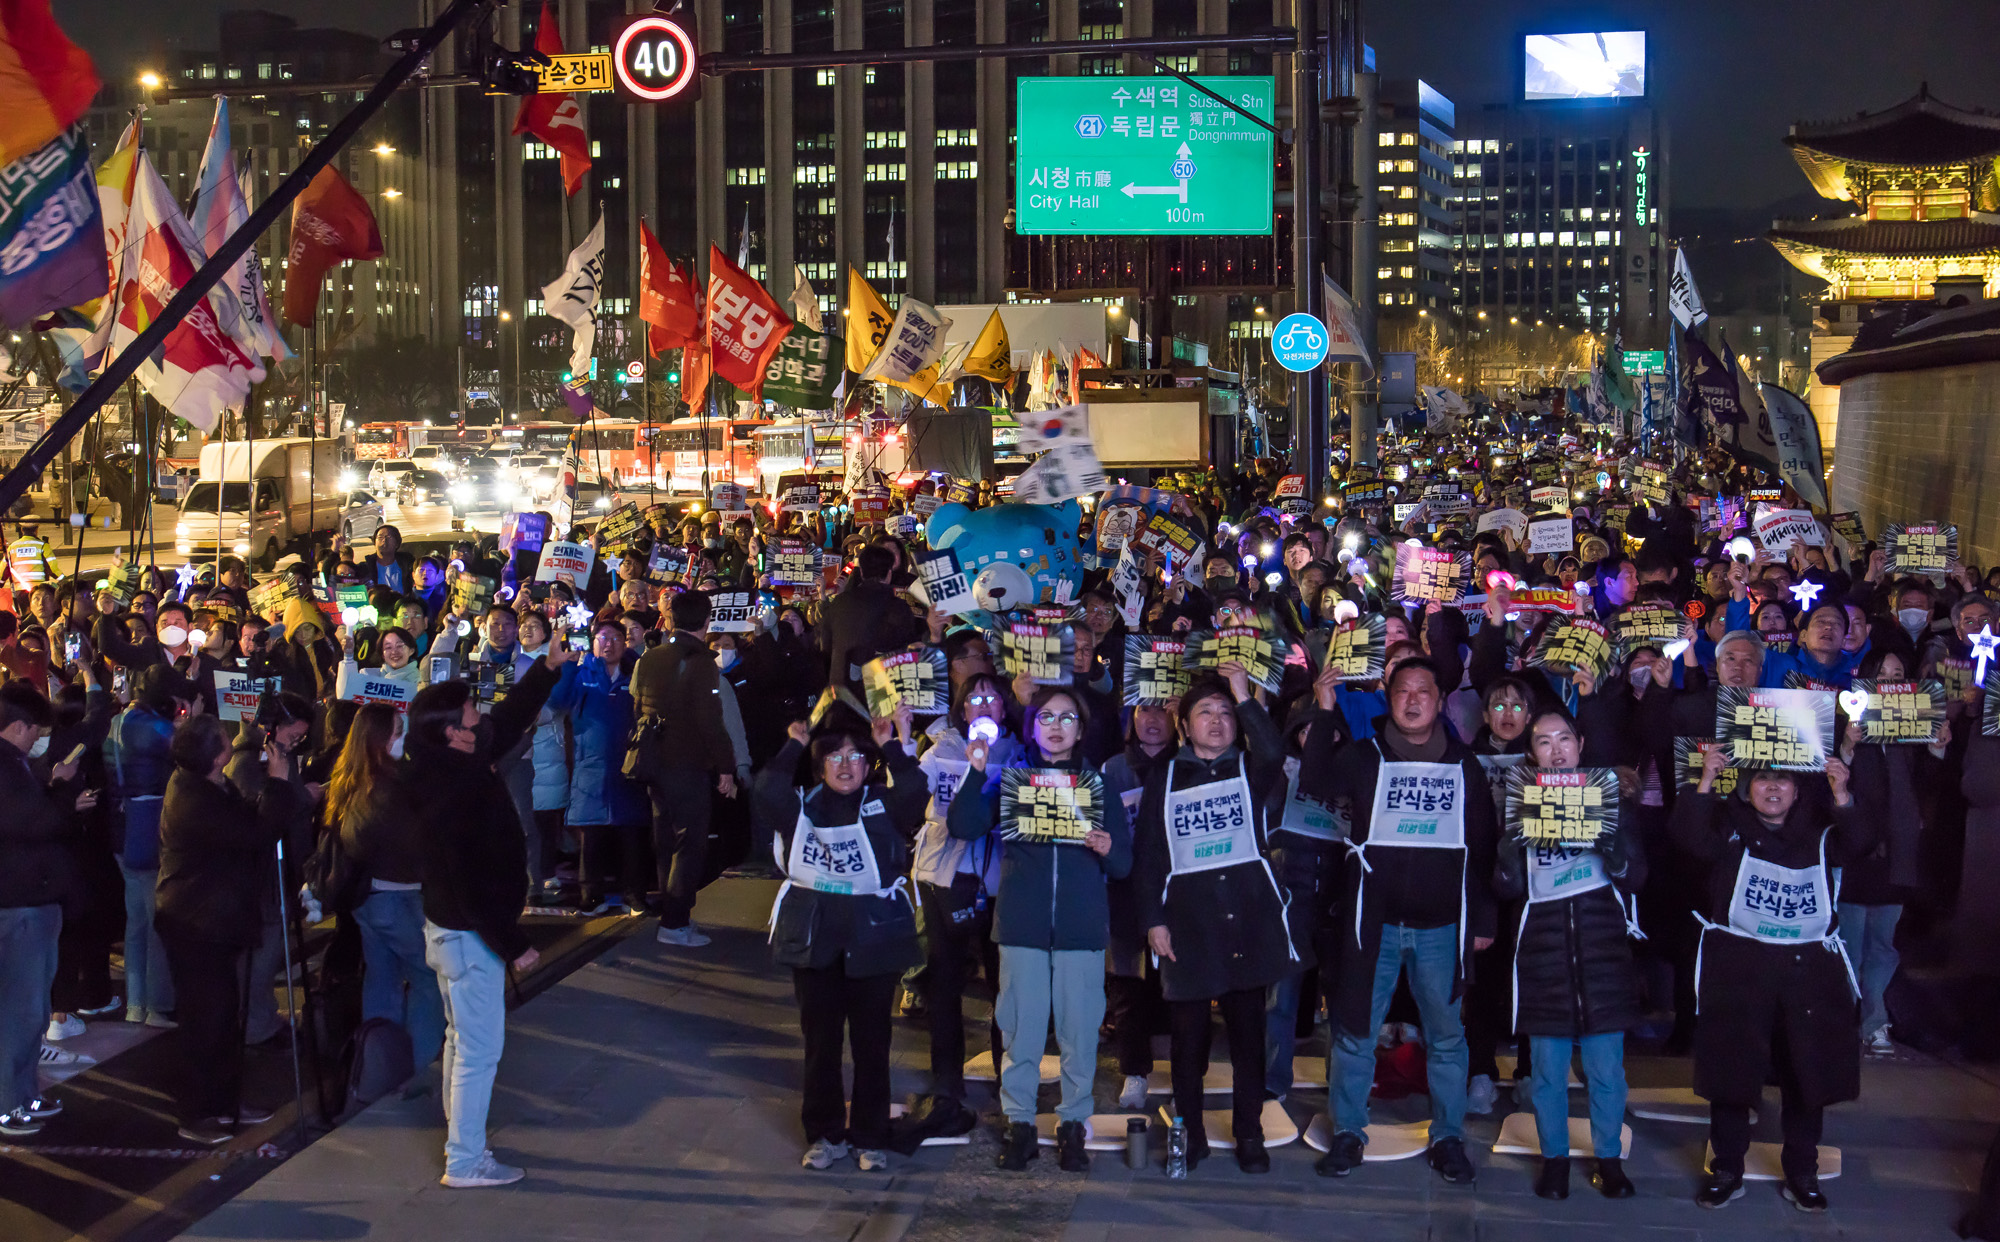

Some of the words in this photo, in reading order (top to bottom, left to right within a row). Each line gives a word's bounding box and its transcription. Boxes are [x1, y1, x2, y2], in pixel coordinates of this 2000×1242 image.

[634, 40, 676, 77] 40
[1111, 86, 1178, 108] 수색역
[1241, 93, 1264, 108] Stn
[1082, 119, 1099, 134] 21
[1110, 115, 1181, 138] 독립문
[1190, 111, 1236, 126] 獨立門
[1189, 129, 1266, 143] Dongnimmun
[1029, 166, 1070, 189] 시청
[1075, 170, 1111, 188] 市廳
[1176, 163, 1191, 176] 50
[1029, 195, 1062, 212] City
[1070, 195, 1099, 209] Hall
[1635, 172, 1647, 226] 하나은행
[1166, 207, 1205, 223] 100m
[710, 273, 775, 349] 보당
[710, 324, 754, 365] 역위원회
[1282, 352, 1320, 361] 자전거전용
[631, 365, 641, 374] 40
[1764, 523, 1816, 545] 해체하라!
[1896, 534, 1947, 547] 윤석열을
[553, 546, 584, 560] 헌재는
[1896, 554, 1947, 567] 파면하라
[543, 557, 587, 573] 즉각파면!
[1408, 558, 1461, 577] 윤석열을
[1405, 582, 1457, 600] 파면하라
[1574, 619, 1605, 636] 내란수괴
[1621, 623, 1678, 637] 파면하라
[229, 678, 265, 692] 헌재는
[364, 681, 405, 699] 헌재는
[1880, 684, 1911, 693] 내란수괴
[1867, 693, 1932, 710] 윤석열을
[1867, 720, 1932, 736] 파면하라
[1734, 739, 1815, 762] 파면하라
[1390, 776, 1418, 788] 윤석열
[1420, 777, 1455, 790] 즉각파면
[1541, 773, 1580, 785] 내란수괴
[1018, 786, 1092, 807] 윤석열을
[1174, 800, 1202, 815] 윤석열
[1204, 792, 1241, 808] 즉각파면
[1386, 788, 1455, 812] 단식농성
[1523, 785, 1602, 806] 윤석열을
[1018, 817, 1093, 838] 파면하라
[1174, 804, 1244, 837] 단식농성
[1522, 818, 1603, 839] 파면하라
[802, 844, 865, 873] 단식농성
[1748, 874, 1780, 893] 윤석열
[1781, 880, 1815, 896] 즉각파면
[1744, 886, 1818, 919] 단식농성
